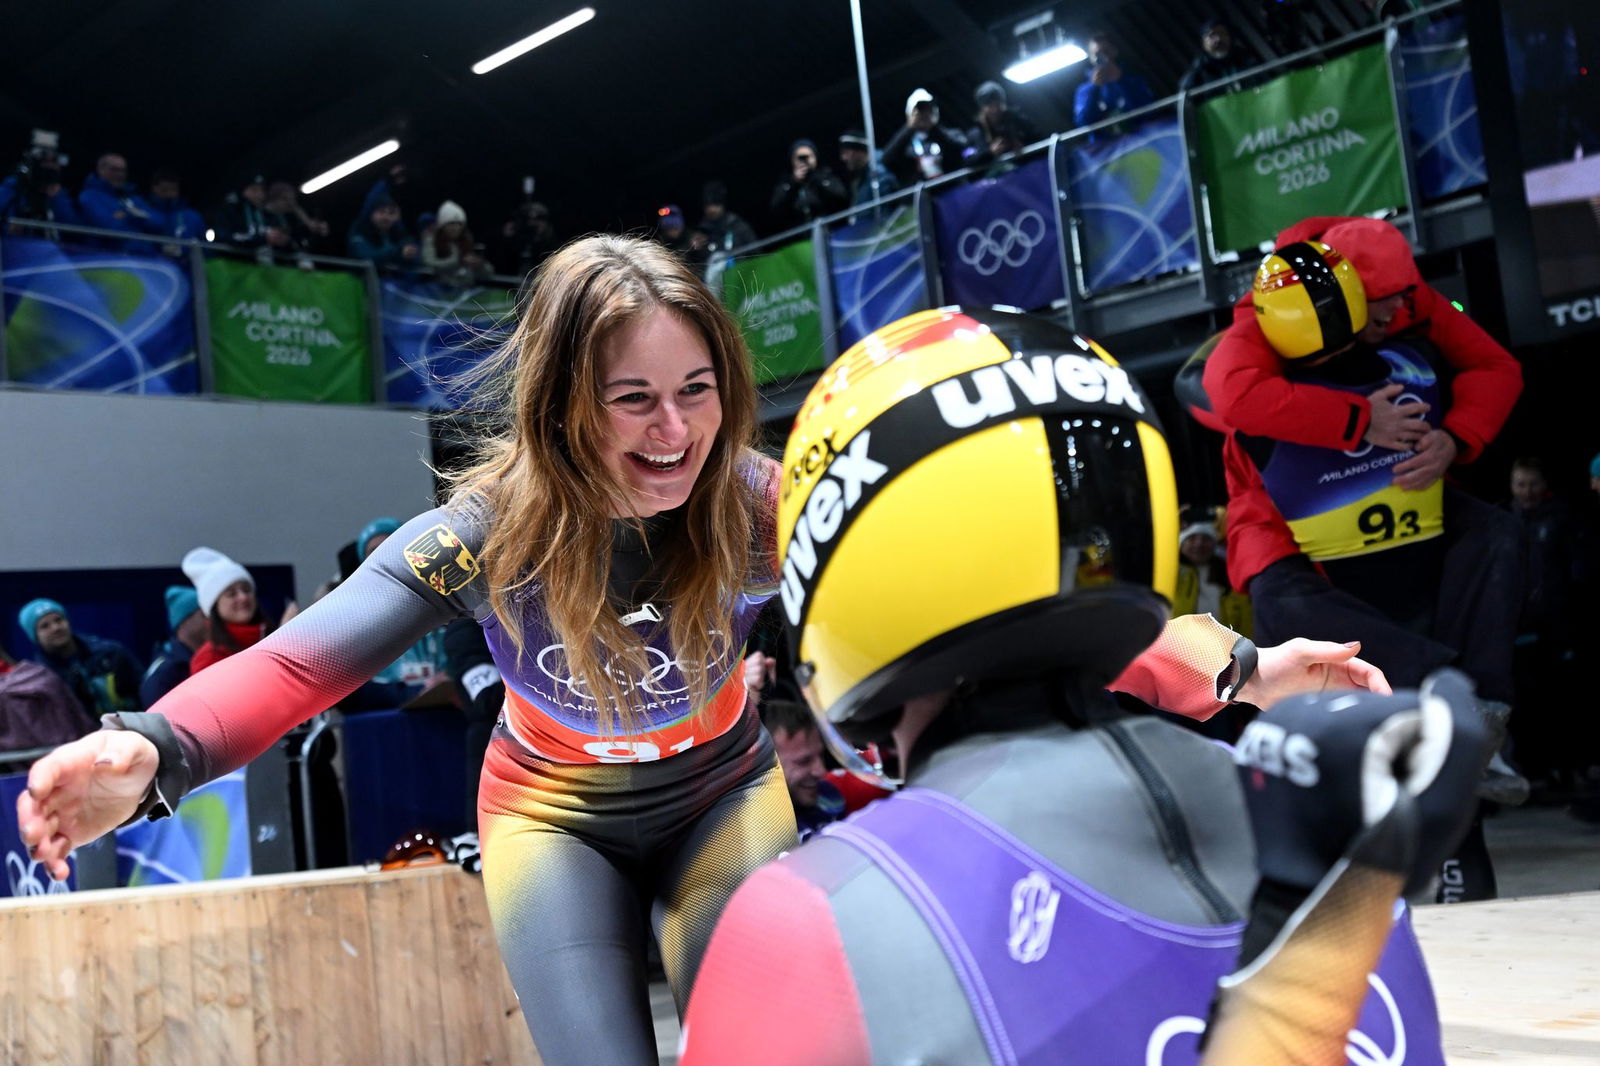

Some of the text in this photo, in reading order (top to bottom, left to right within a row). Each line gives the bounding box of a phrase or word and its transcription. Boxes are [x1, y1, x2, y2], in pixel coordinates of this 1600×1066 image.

[1234, 107, 1340, 158] MILANO
[1254, 129, 1366, 175] CORTINA
[1278, 162, 1331, 195] 2026
[227, 301, 324, 326] MILANO
[245, 321, 342, 349] CORTINA
[265, 345, 312, 366] 2026
[931, 354, 1146, 429] uvex
[1318, 462, 1370, 484] MILANO
[780, 430, 890, 627] uvex
